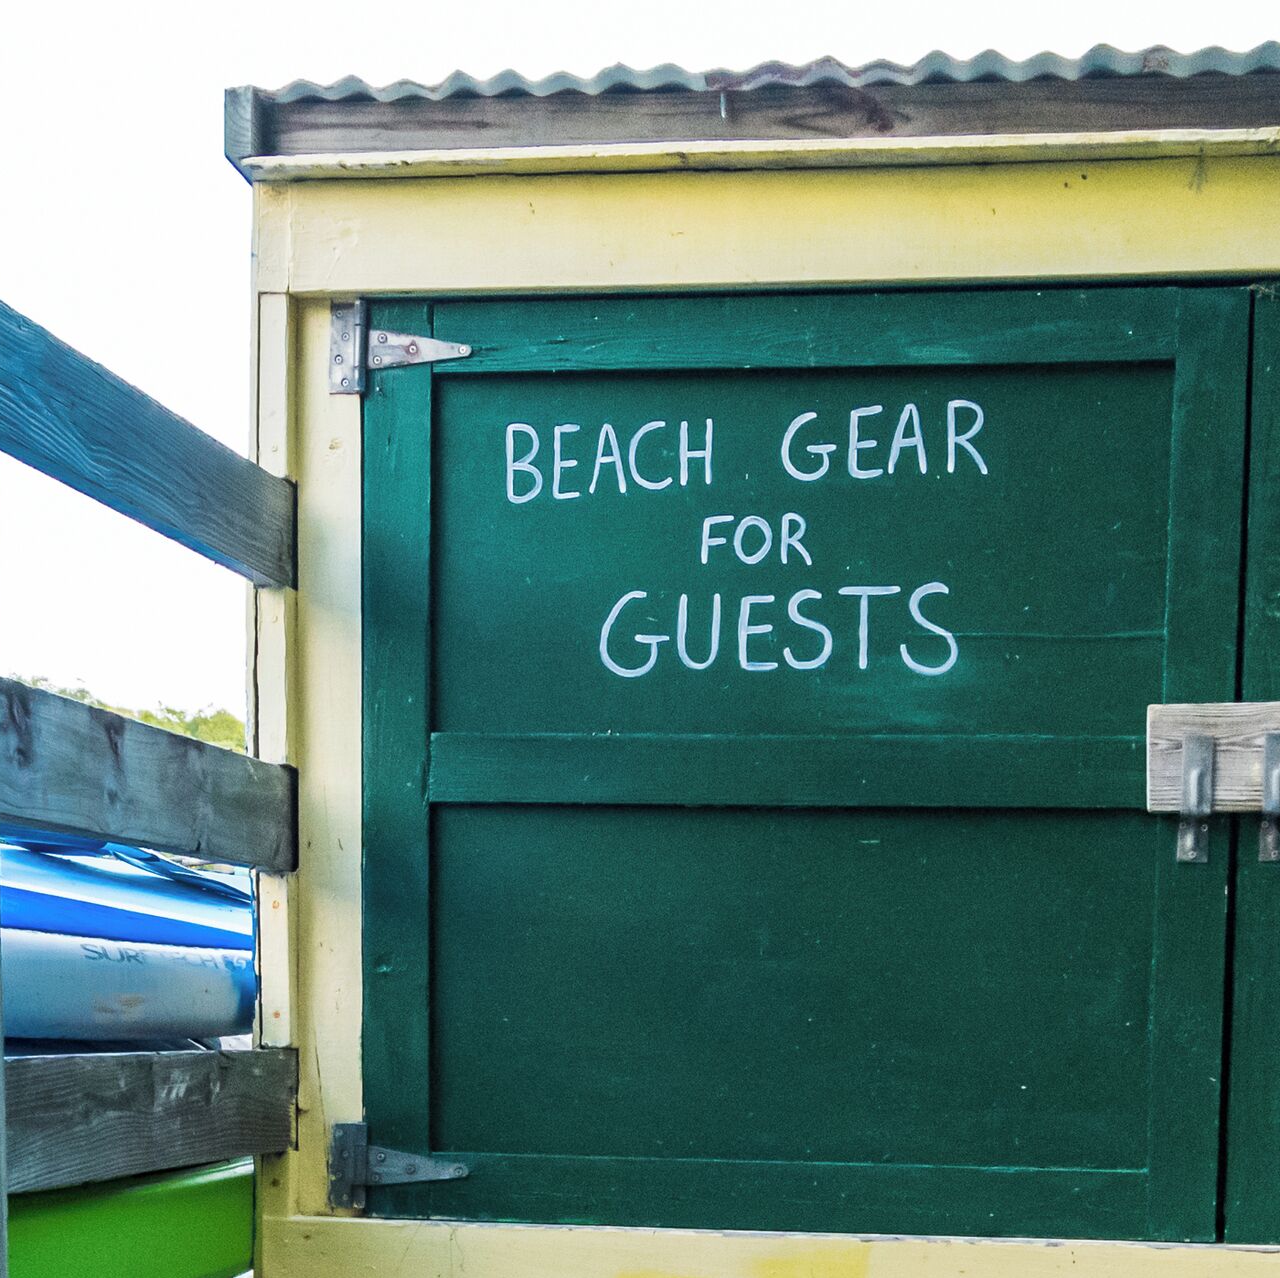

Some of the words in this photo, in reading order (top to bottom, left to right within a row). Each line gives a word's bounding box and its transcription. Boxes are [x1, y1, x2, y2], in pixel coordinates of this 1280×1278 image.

[505, 418, 714, 504] BEACH
[780, 399, 989, 482] GEAR
[700, 512, 813, 566] FOR
[599, 581, 960, 679] GUESTS
